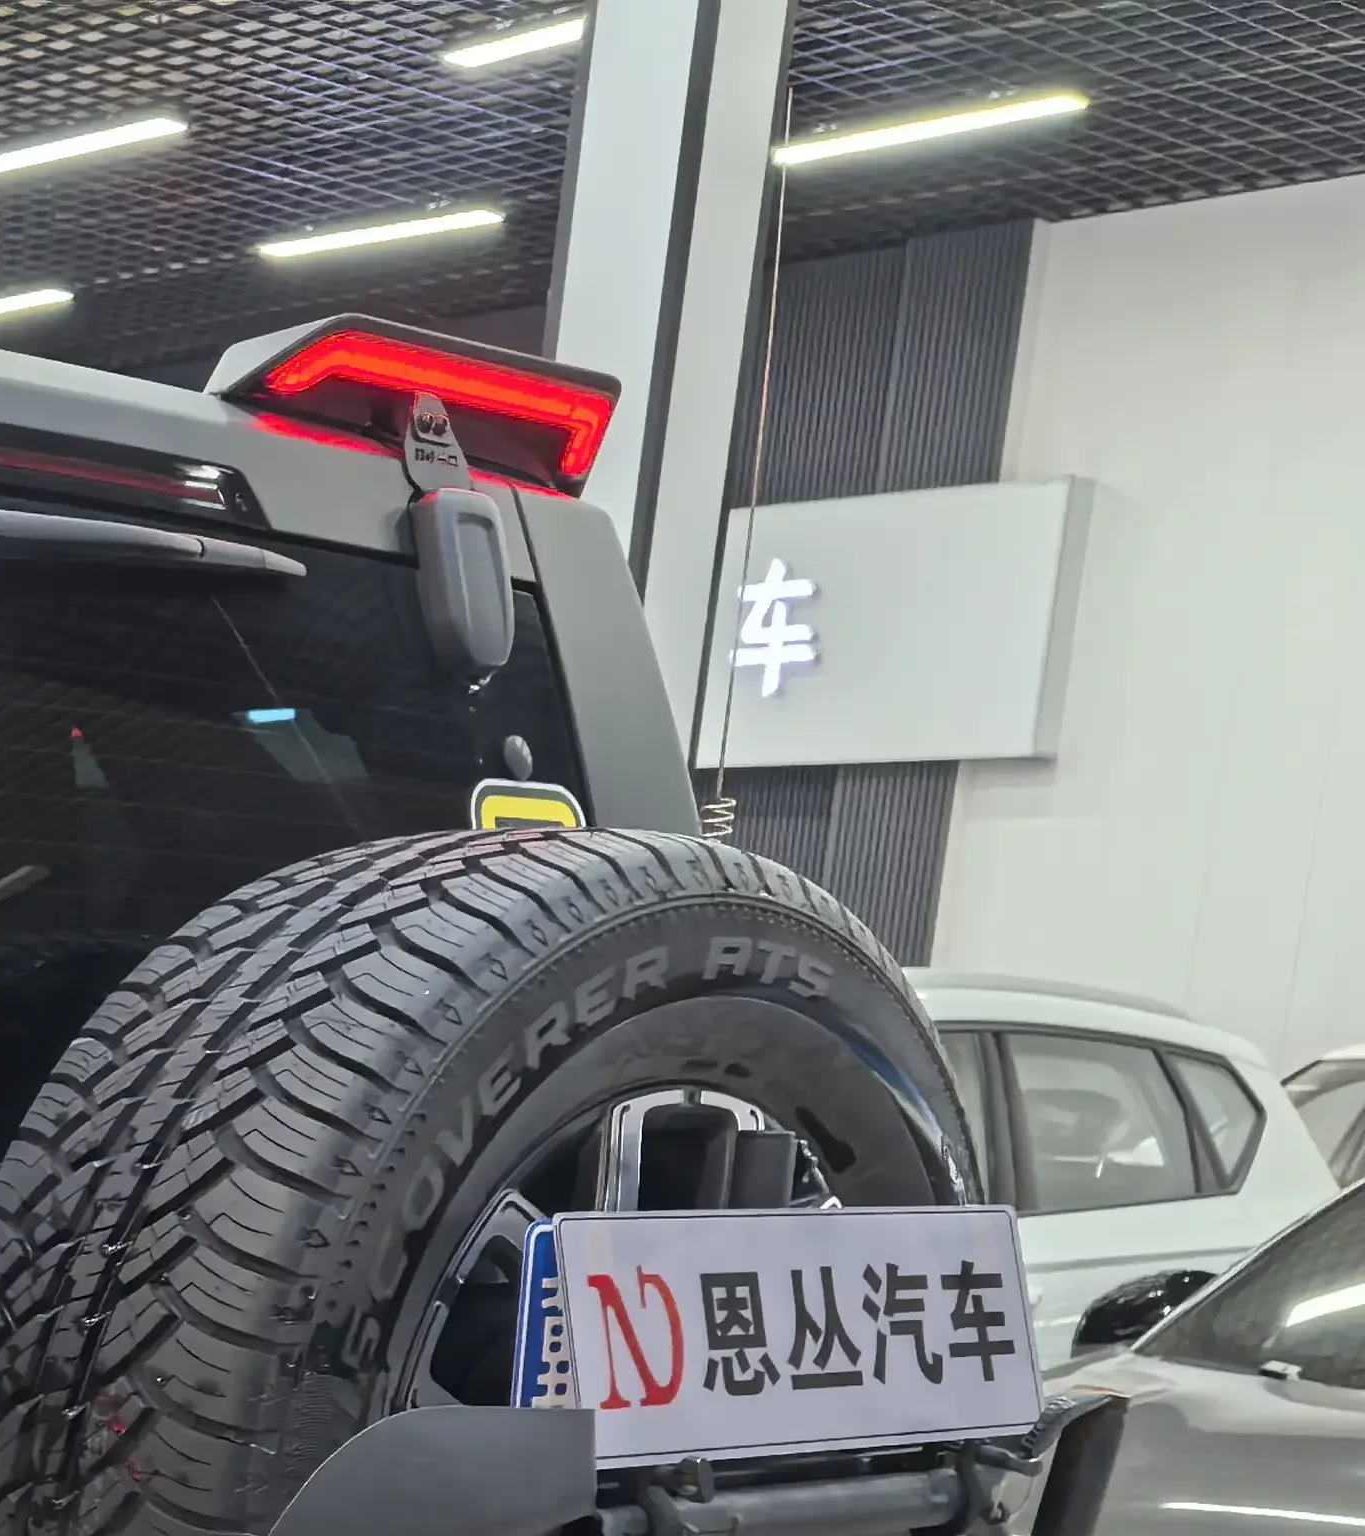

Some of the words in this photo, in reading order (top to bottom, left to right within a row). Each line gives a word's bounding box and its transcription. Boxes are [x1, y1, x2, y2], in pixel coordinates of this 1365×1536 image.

[728, 557, 819, 698] 车
[701, 936, 836, 998] ATS
[699, 1261, 1016, 1396] 恩丛汽车
